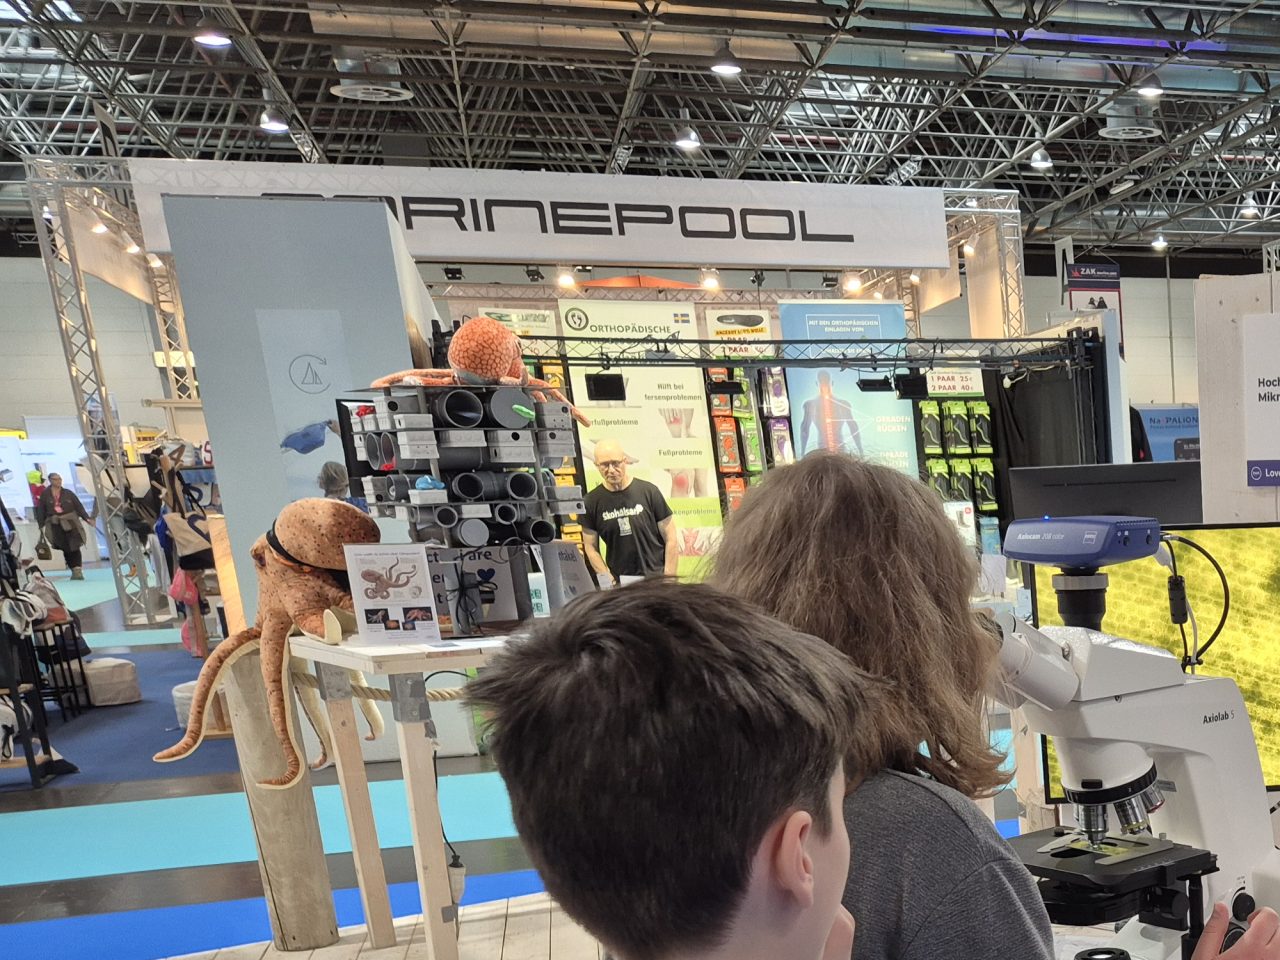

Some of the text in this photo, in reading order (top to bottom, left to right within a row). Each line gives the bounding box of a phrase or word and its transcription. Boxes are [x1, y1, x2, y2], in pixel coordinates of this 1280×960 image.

[261, 192, 855, 243] RINEPOOL
[1080, 267, 1097, 275] ZAK
[590, 322, 671, 334] ORTHOPÄDISCHE
[591, 418, 639, 427] rfußprobleme
[674, 508, 717, 517] kenprobleme
[1203, 709, 1235, 725] Axiolab 5
